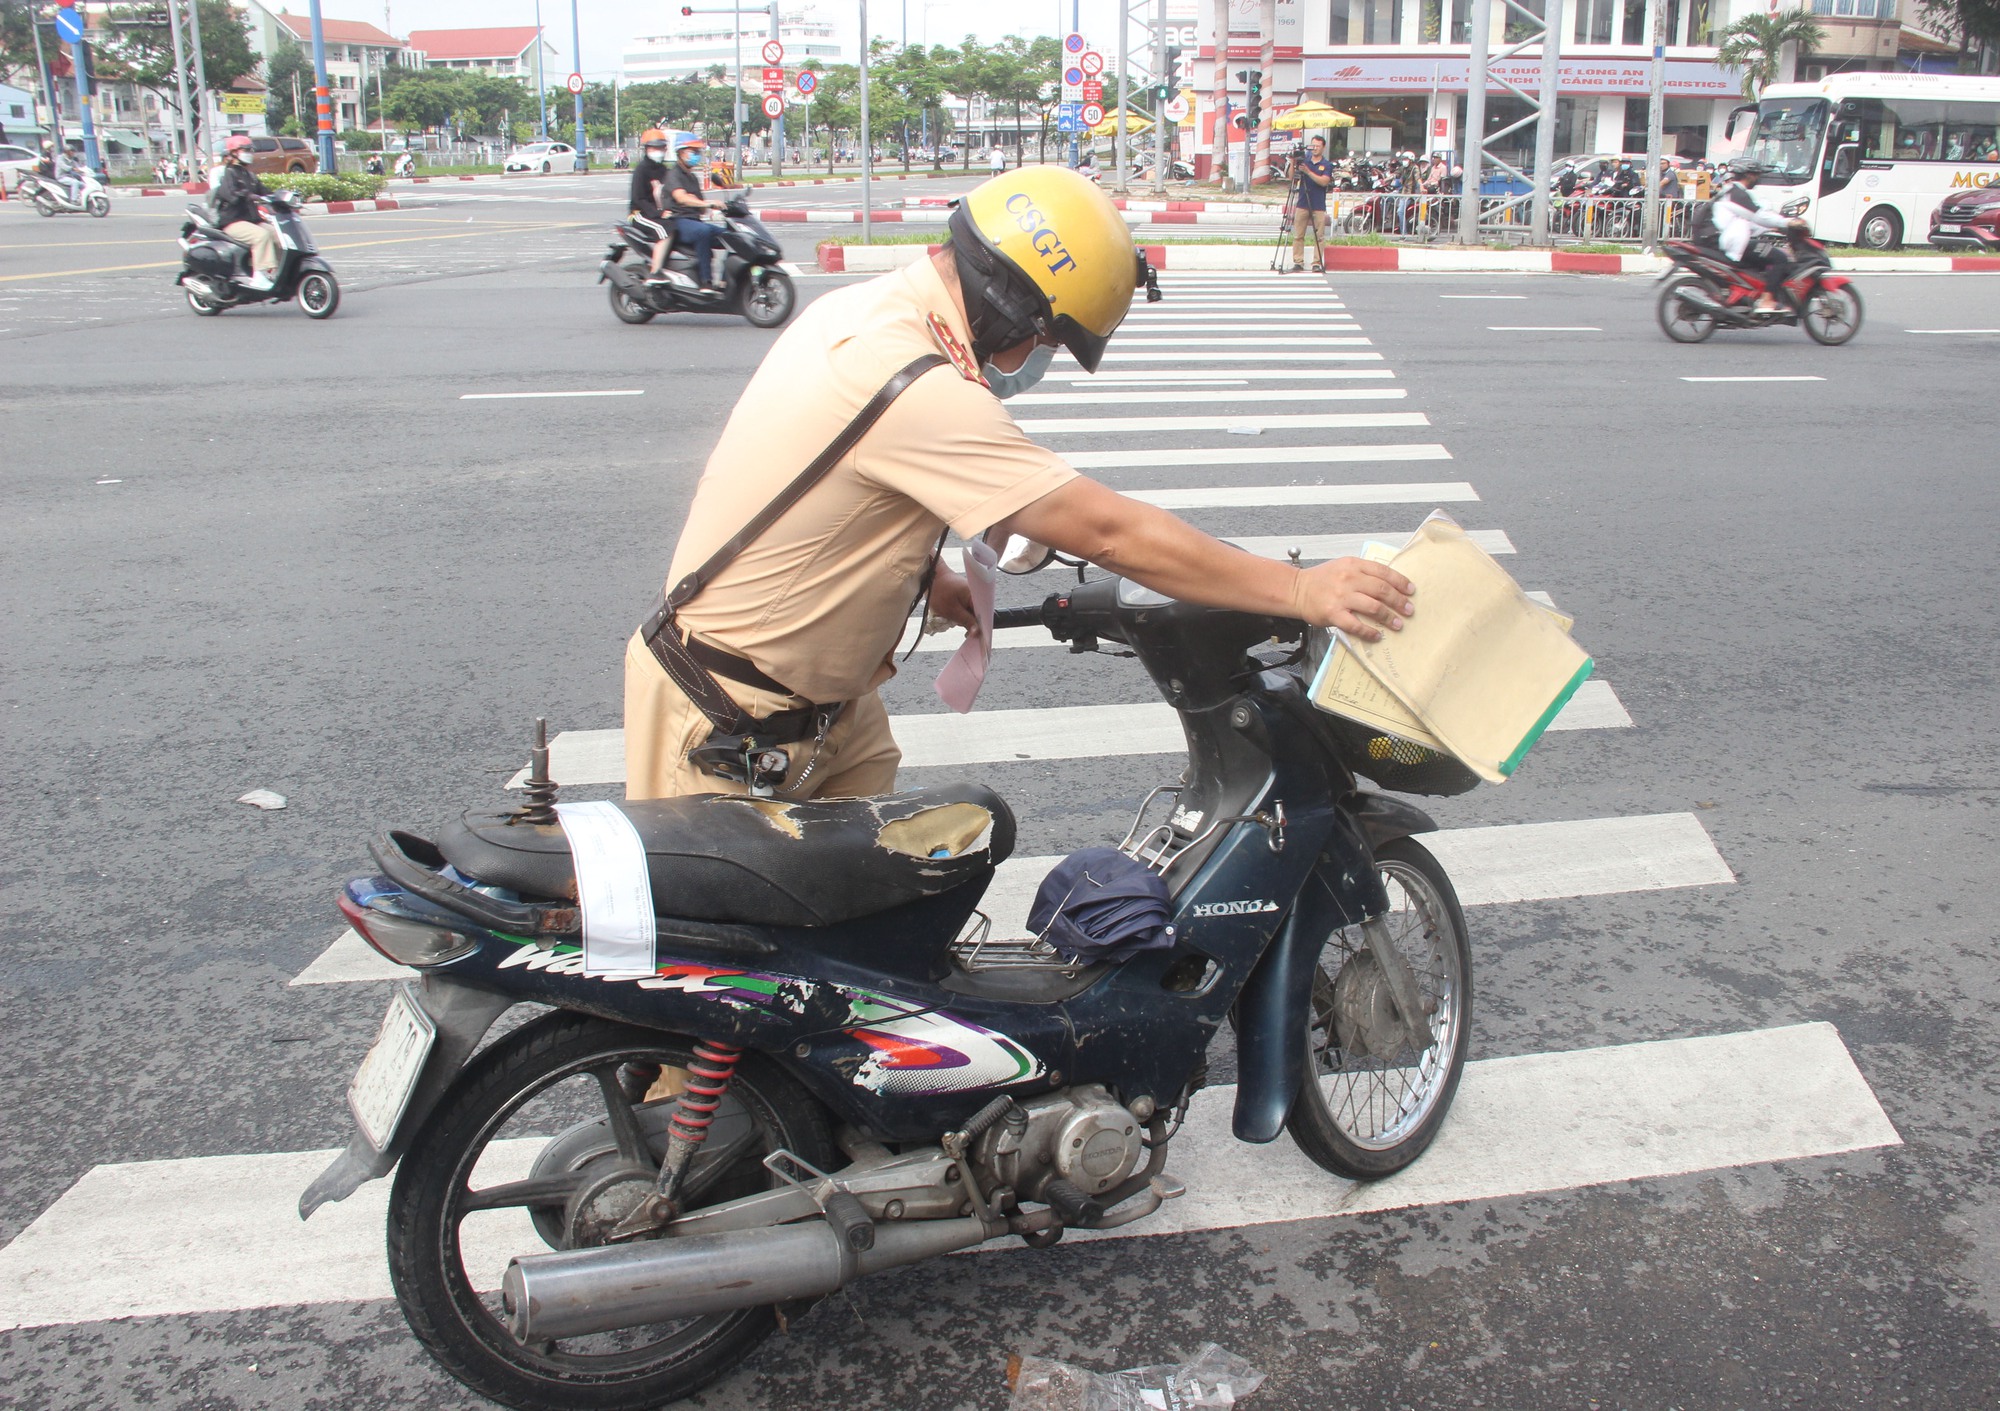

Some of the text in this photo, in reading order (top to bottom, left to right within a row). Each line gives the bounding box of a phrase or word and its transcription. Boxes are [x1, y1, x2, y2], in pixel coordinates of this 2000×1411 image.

[1649, 80, 1727, 89] GISTICS
[769, 101, 779, 113] 60
[1088, 109, 1099, 121] 50
[1006, 193, 1077, 277] CSGT
